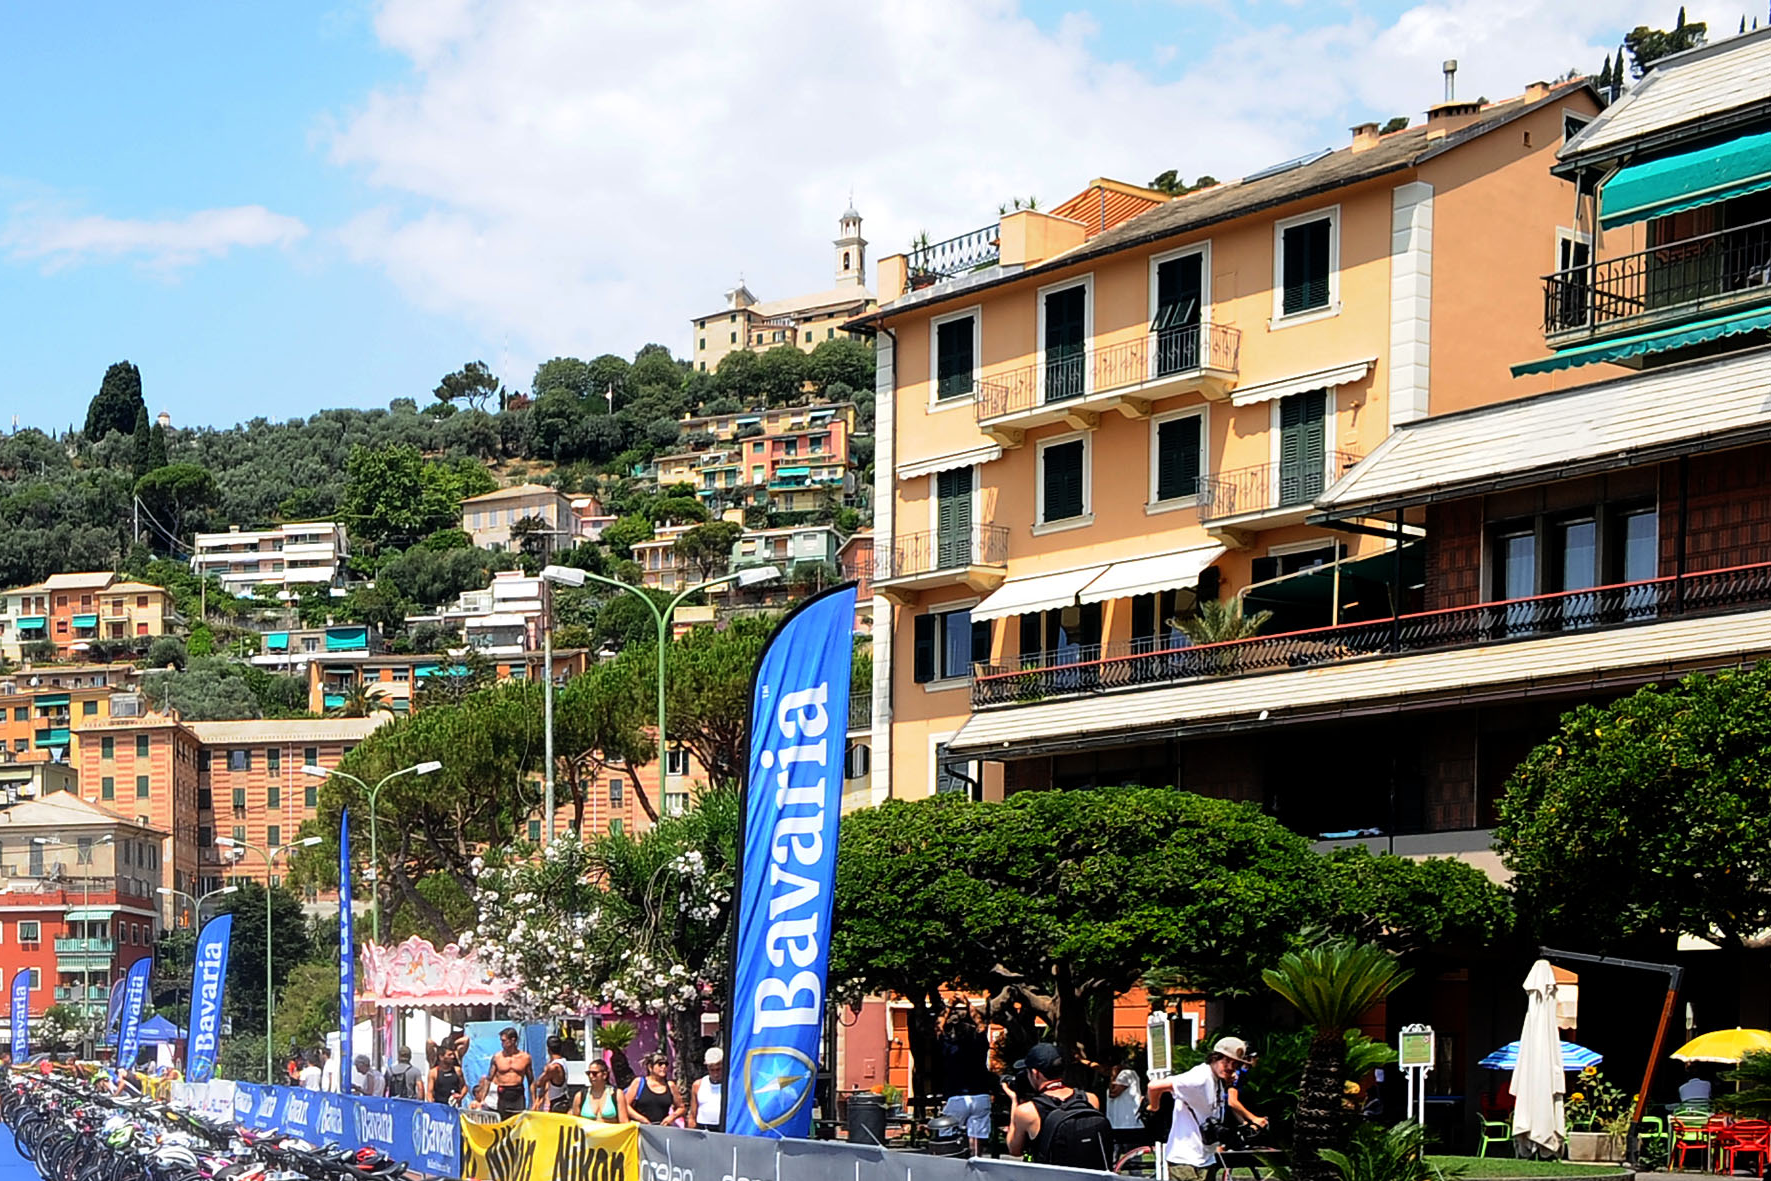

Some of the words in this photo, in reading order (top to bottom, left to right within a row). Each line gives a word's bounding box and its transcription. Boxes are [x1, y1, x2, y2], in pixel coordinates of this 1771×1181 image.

[752, 681, 829, 1035] Bavaria
[14, 985, 28, 1051] Bavaria
[123, 974, 145, 1056] Bavaria
[194, 942, 223, 1052] Bavaria
